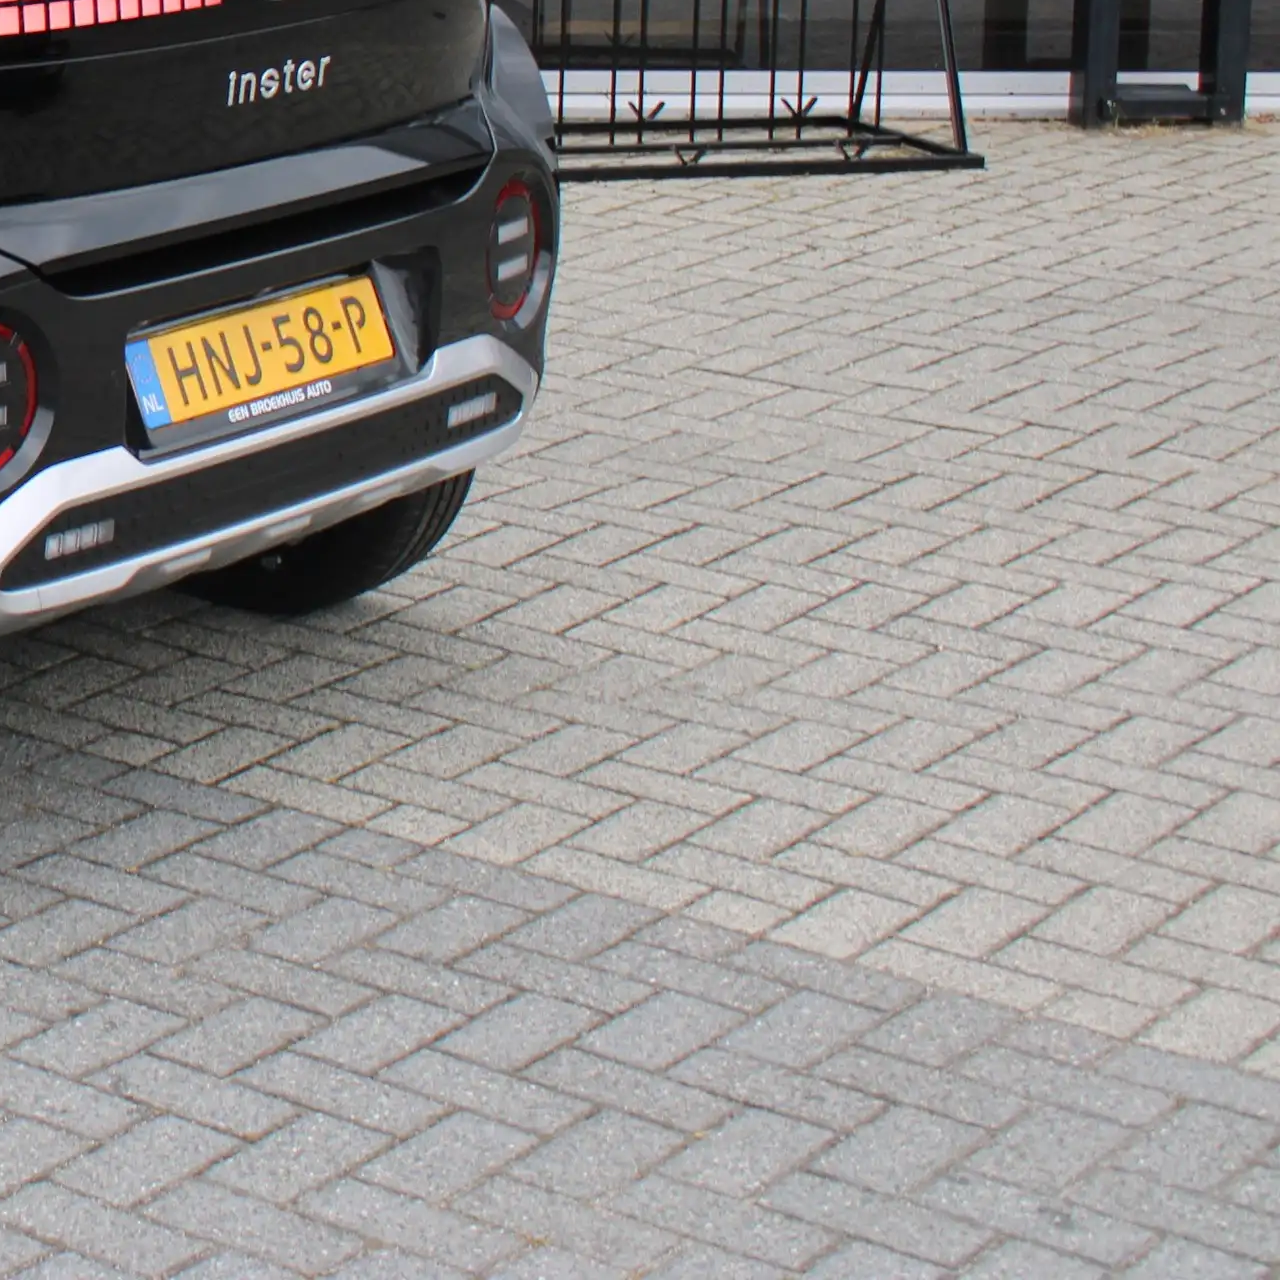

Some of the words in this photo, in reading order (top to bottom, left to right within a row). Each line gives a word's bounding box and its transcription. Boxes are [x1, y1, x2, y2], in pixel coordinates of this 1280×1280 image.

[226, 55, 332, 108] inster
[167, 295, 367, 407] HNJ-58-P
[142, 394, 165, 416] NL
[228, 404, 250, 423] EEN
[250, 387, 306, 417] BROEKHUIS
[306, 379, 333, 400] AUTO
